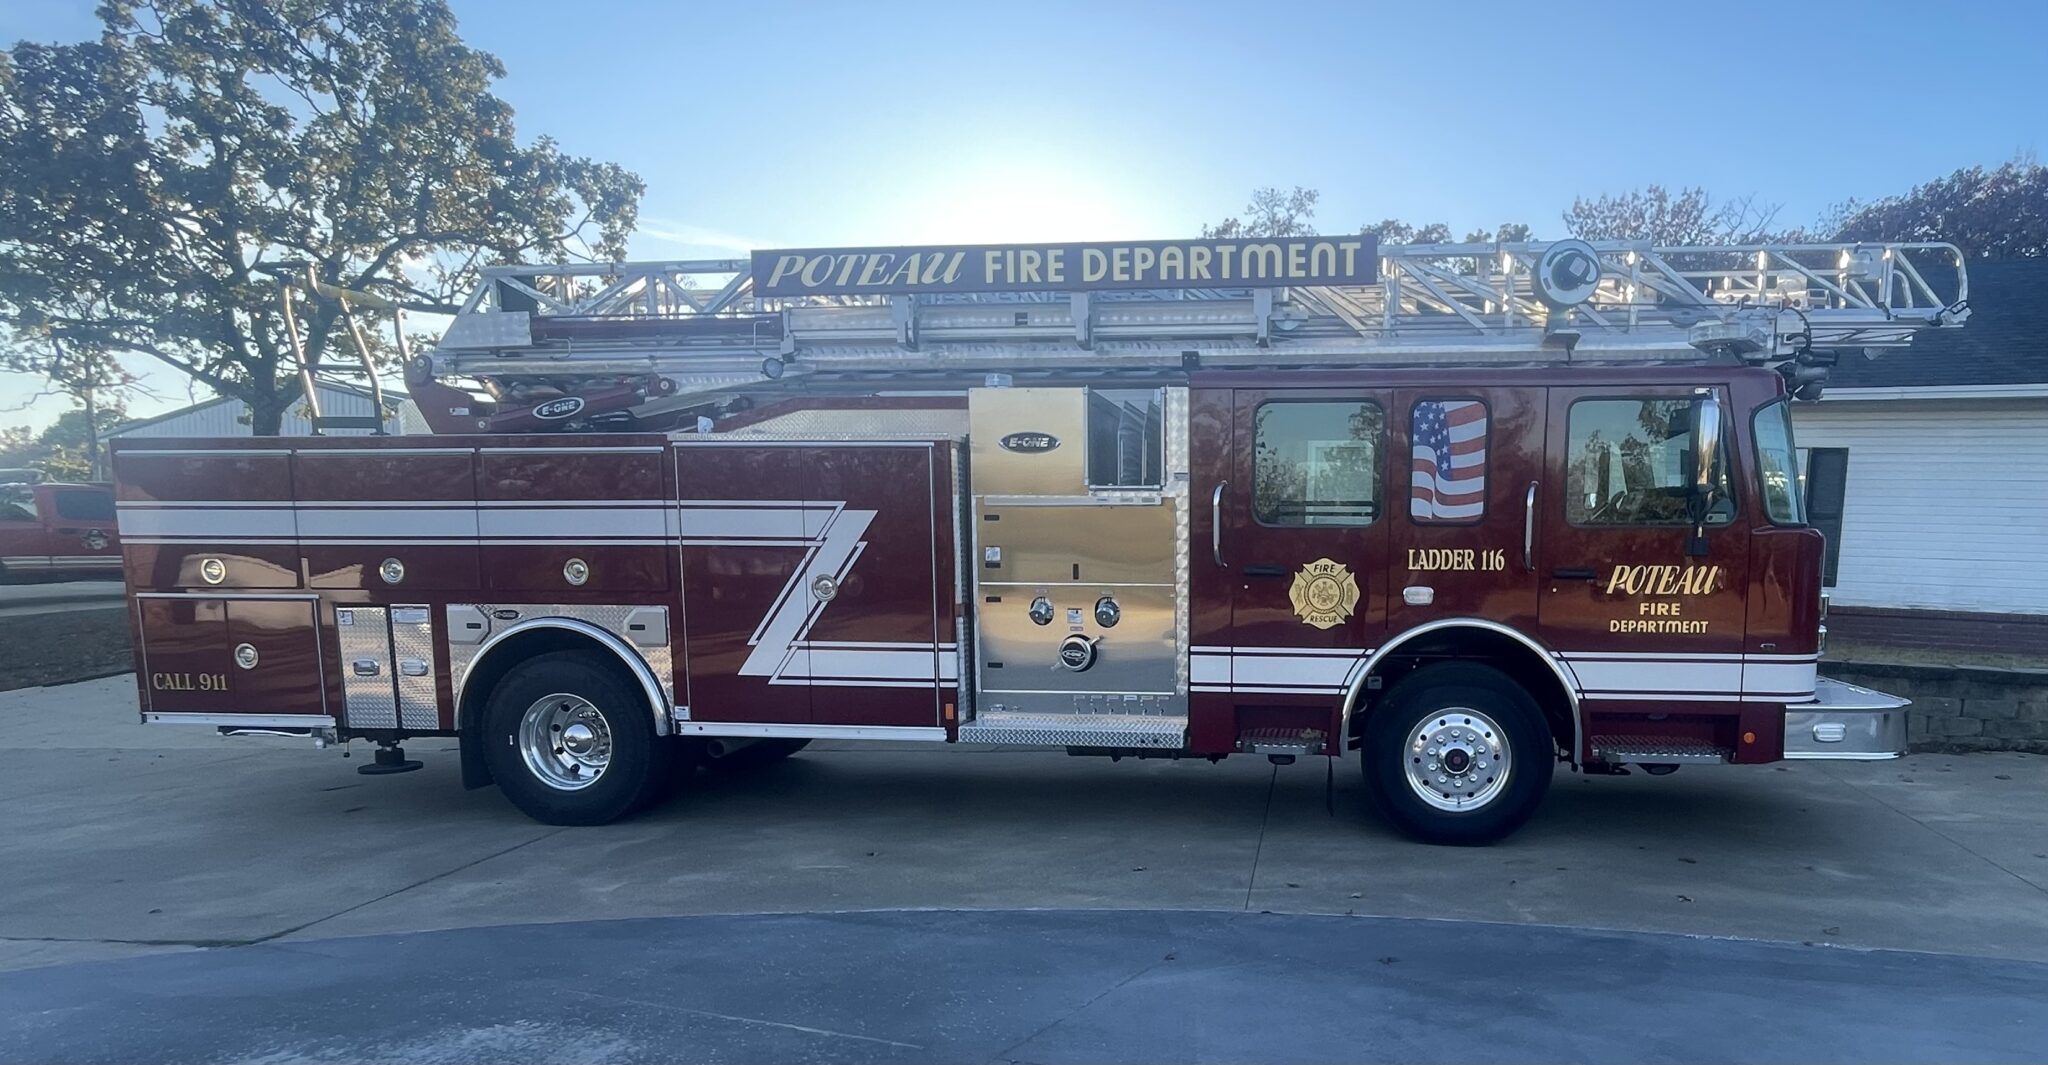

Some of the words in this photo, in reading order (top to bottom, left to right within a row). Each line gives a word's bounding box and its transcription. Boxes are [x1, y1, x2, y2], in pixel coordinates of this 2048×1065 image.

[767, 252, 966, 288] POTEAU
[986, 249, 1064, 283] FIRE
[1083, 242, 1361, 282] DEPARTMENT
[542, 401, 576, 416] E-ONE
[1009, 437, 1050, 448] E-ONE
[1408, 549, 1475, 570] LADDER
[1481, 549, 1505, 571] 116
[1313, 564, 1335, 573] FIRE
[1606, 565, 1718, 594] POTEAU
[1640, 603, 1680, 616] FIRE
[1310, 615, 1337, 623] RESCUE
[1610, 620, 1709, 634] DEPARTMENT
[153, 673, 195, 690] CALL
[199, 673, 228, 690] 911
